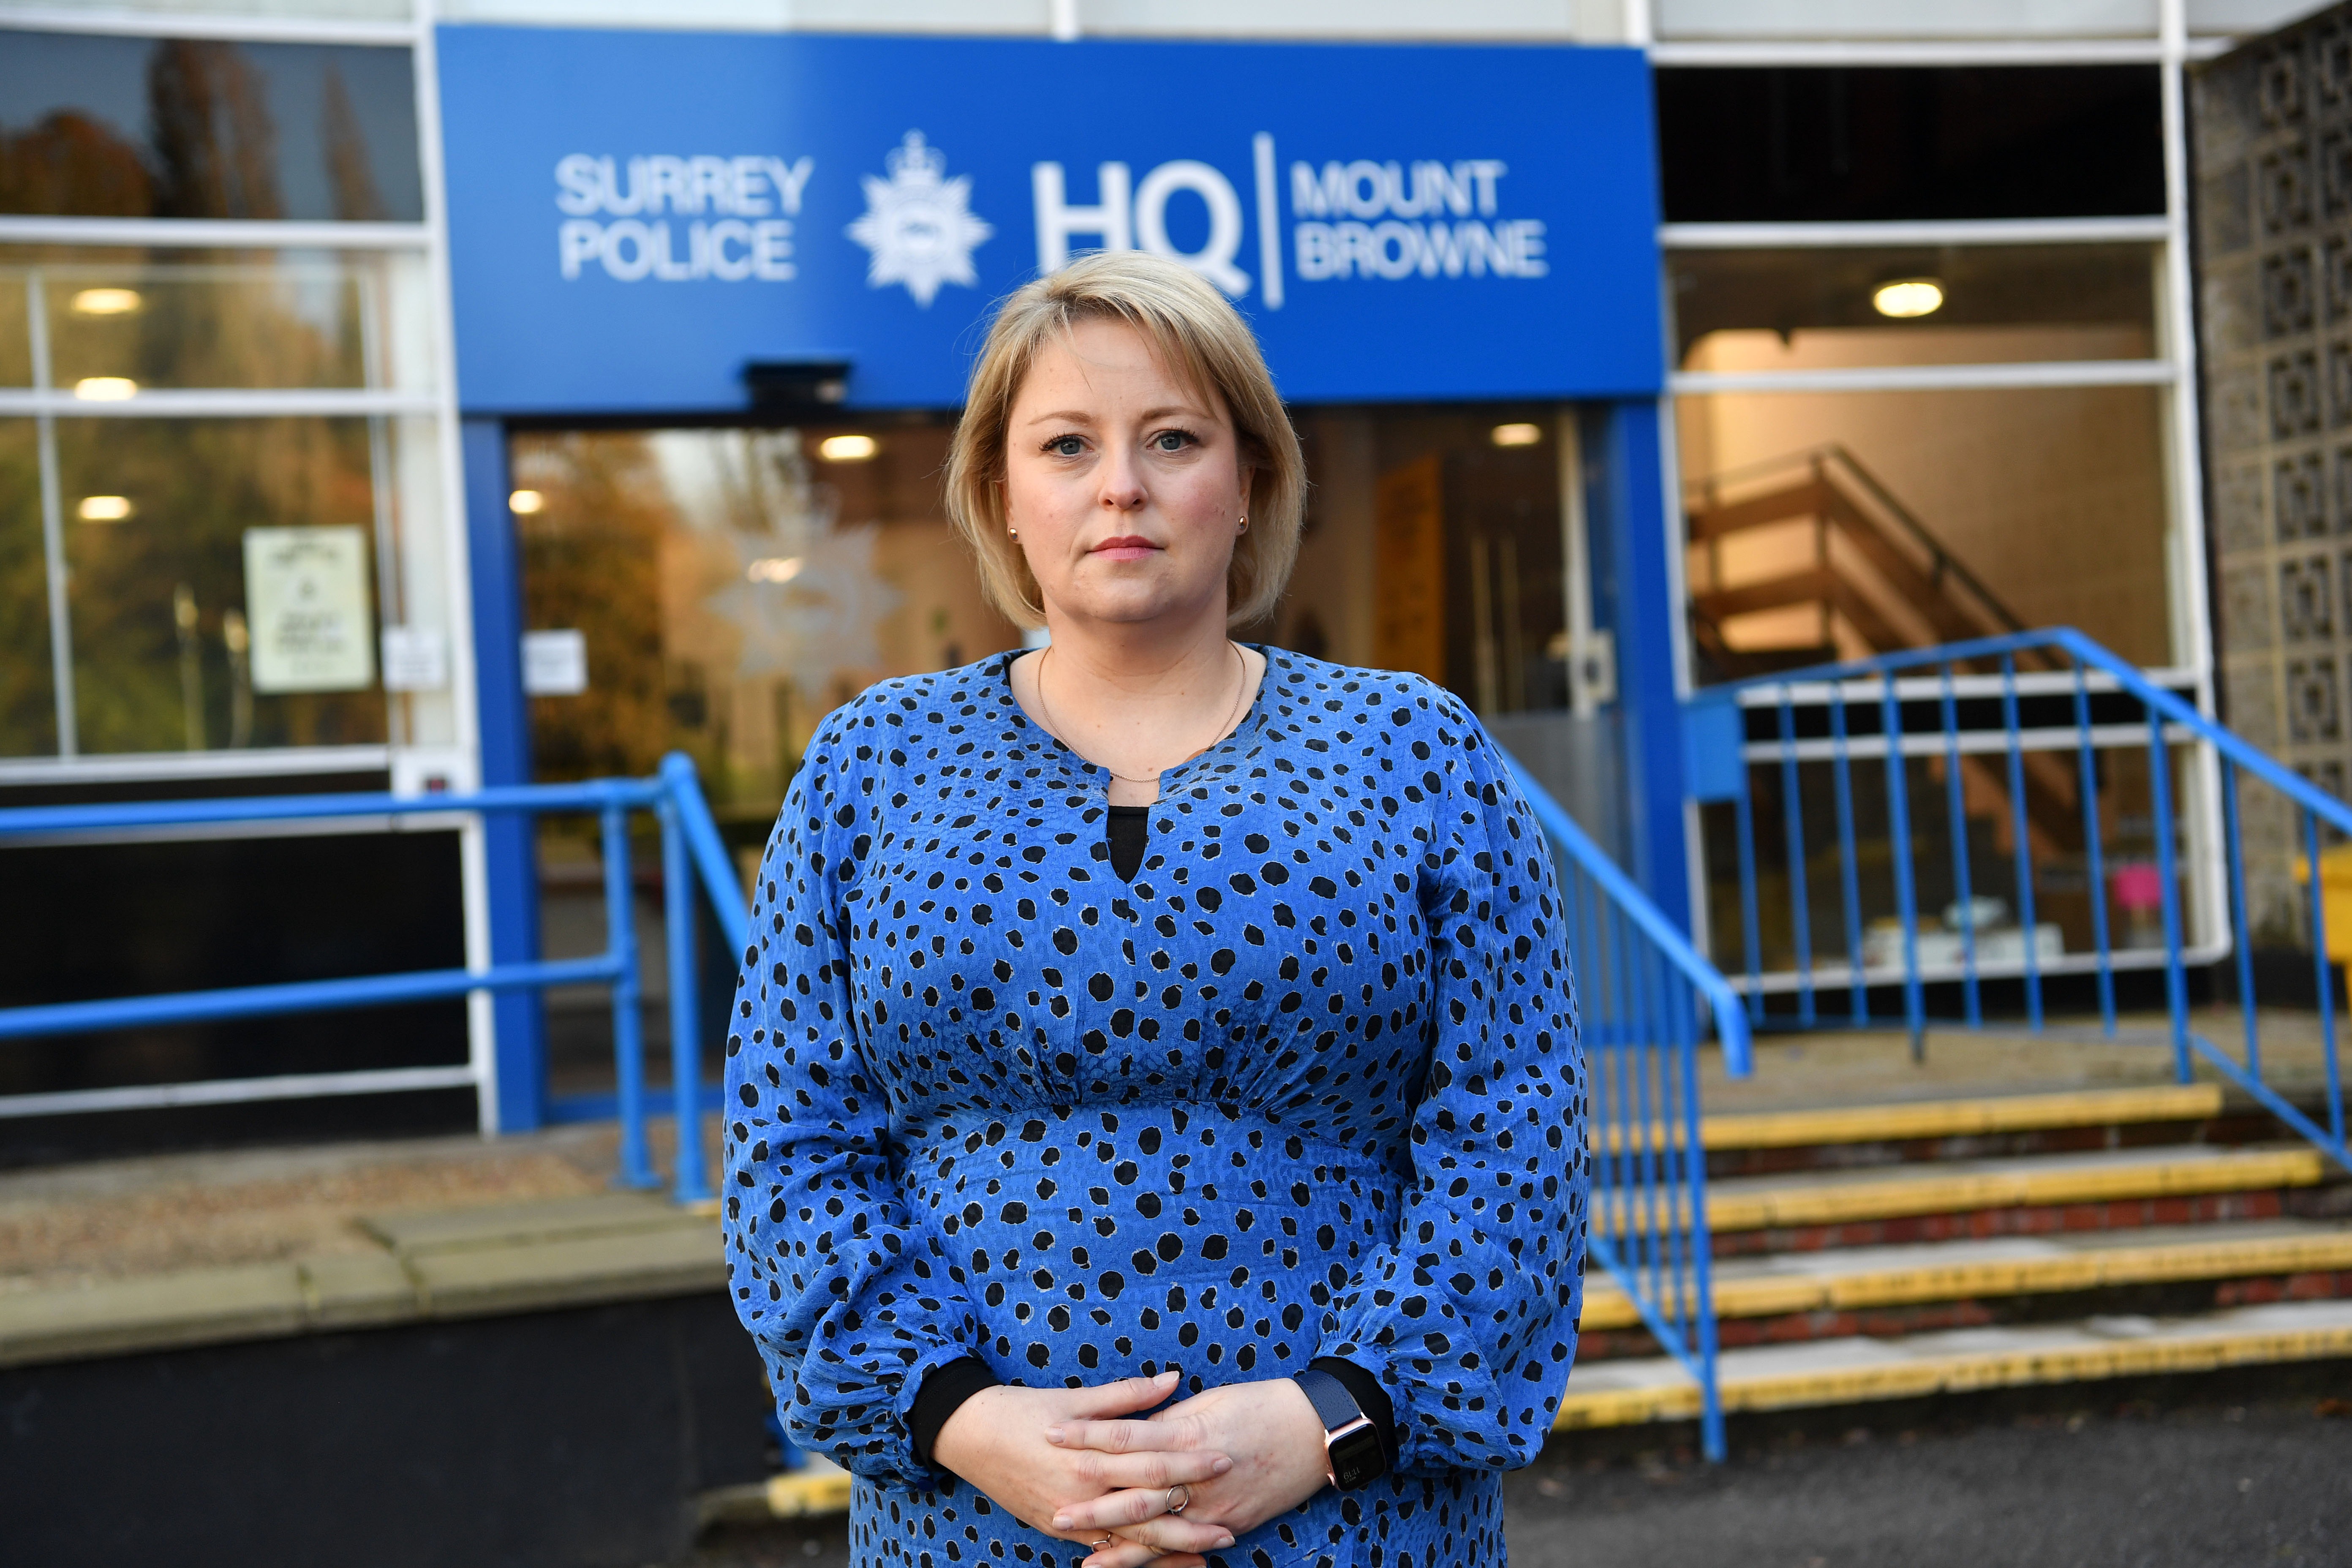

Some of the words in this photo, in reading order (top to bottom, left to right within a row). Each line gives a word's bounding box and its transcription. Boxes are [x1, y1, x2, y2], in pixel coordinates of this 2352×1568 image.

[555, 154, 814, 216] SURREY
[1291, 160, 1507, 218] MOUNT
[558, 218, 798, 282] POLICE
[1031, 159, 1253, 297] HQ
[1294, 220, 1549, 281] BROWNE
[1344, 1466, 1360, 1480] 11:19
